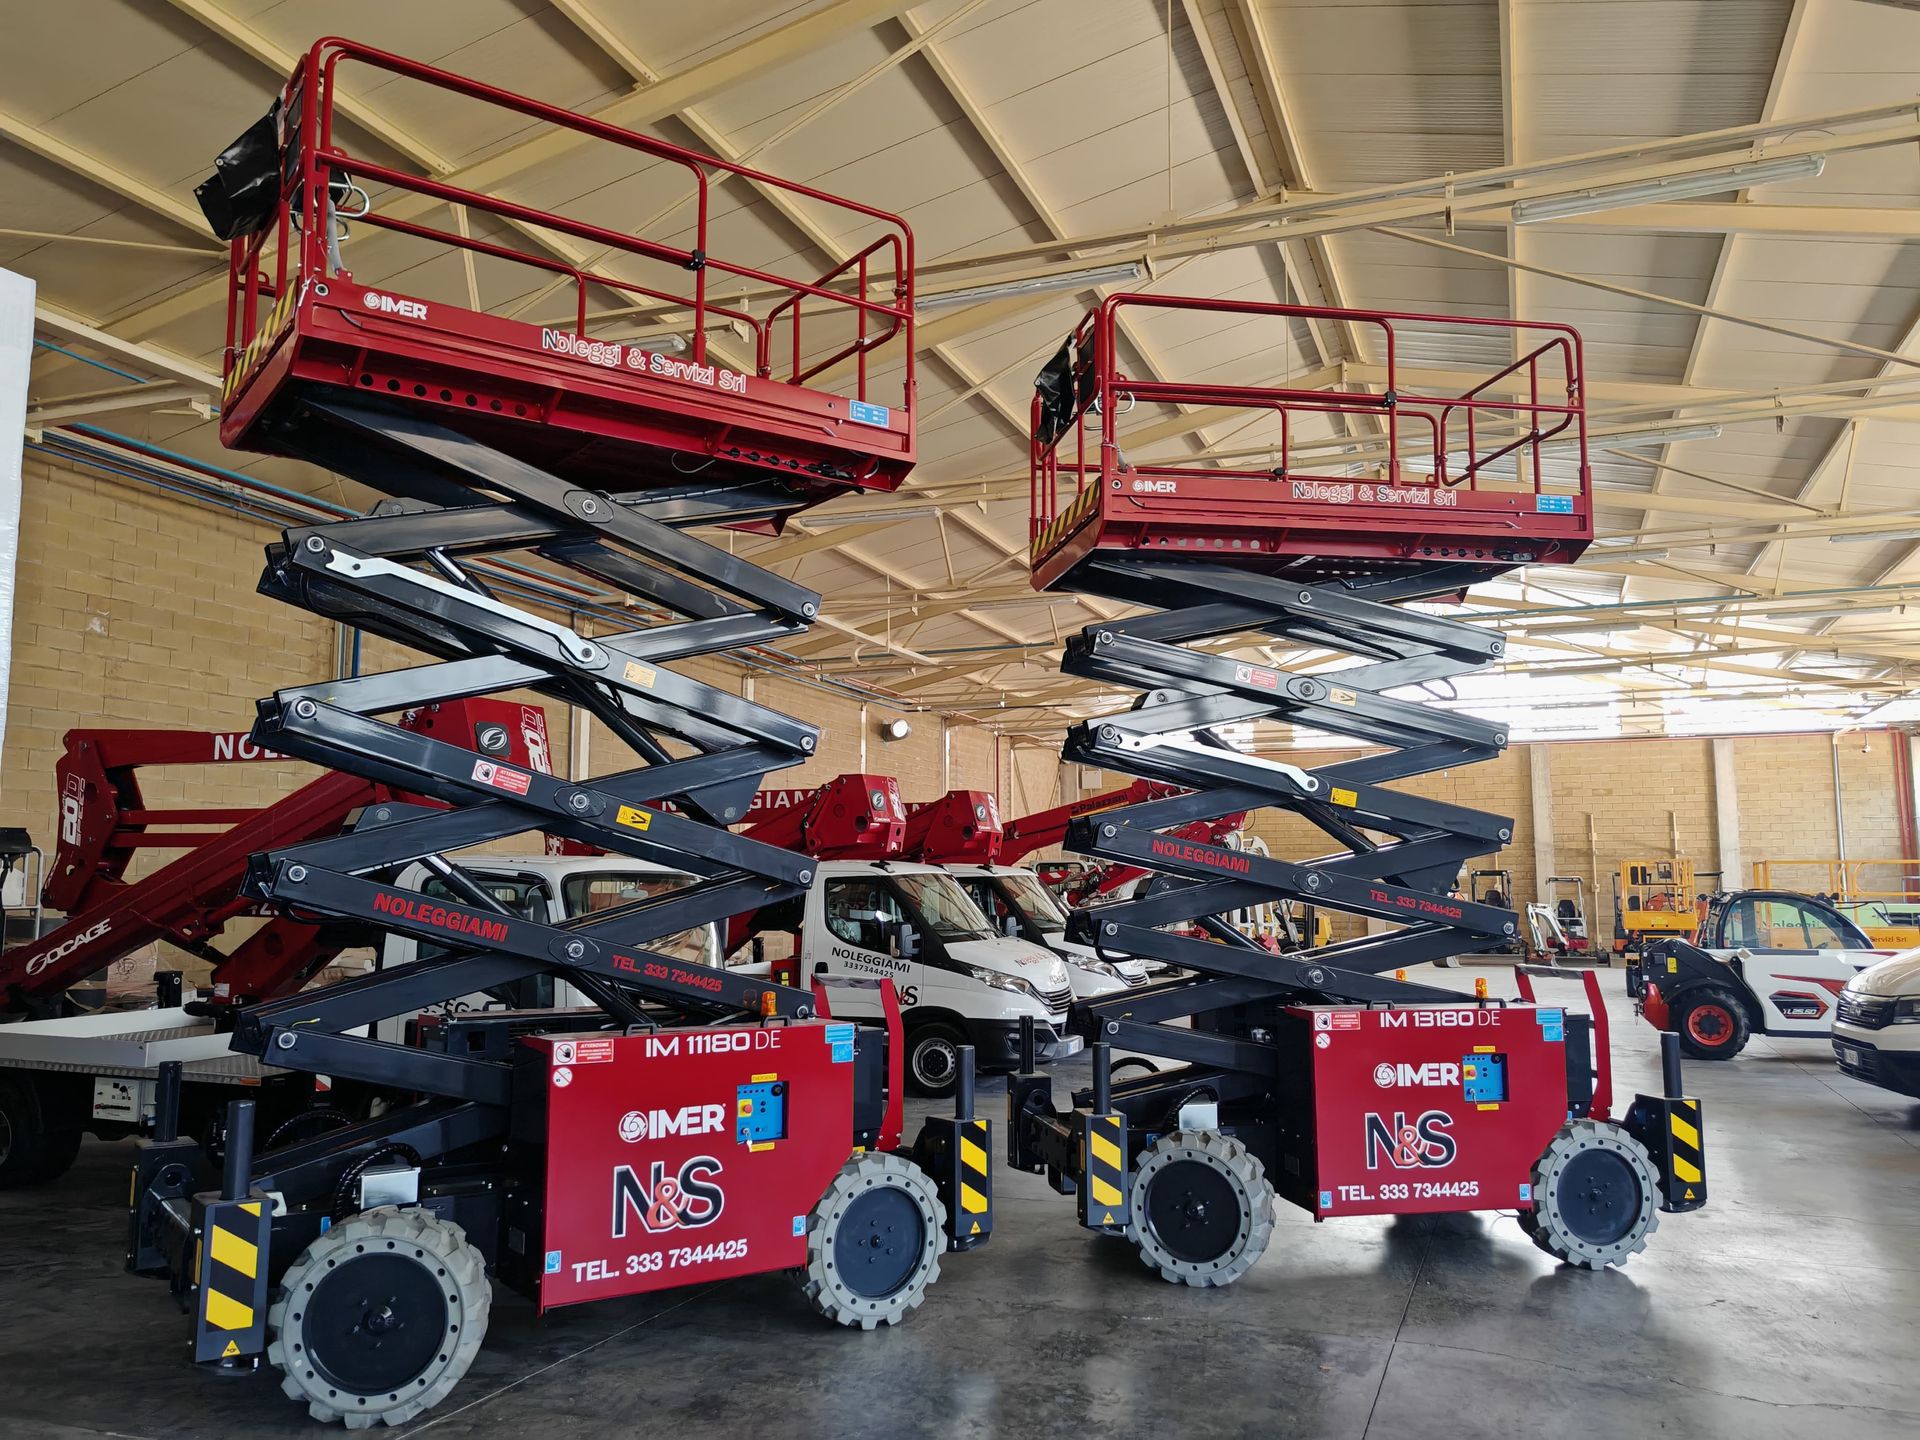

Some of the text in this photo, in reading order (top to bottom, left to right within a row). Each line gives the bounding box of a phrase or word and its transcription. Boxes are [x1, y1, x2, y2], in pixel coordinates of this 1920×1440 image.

[381, 296, 427, 320] IMER
[543, 328, 746, 392] Noleggi & Servizi Srl
[1144, 481, 1176, 492] IMER
[1293, 482, 1456, 505] Noleggi & Servizi Srl
[1152, 840, 1249, 873] NOLEGGIAMI
[373, 893, 508, 942] NOLEGGIAMI
[1396, 896, 1416, 908] 333
[1419, 900, 1462, 919] 7344425
[831, 947, 911, 973] NOLEGGIAMI
[844, 961, 894, 978] 3337344425
[644, 963, 668, 979] 333
[671, 969, 722, 992] 7344425
[1380, 1011, 1500, 1027] IM 13180 DE
[645, 1030, 781, 1057] IM 11180 DE
[1397, 1063, 1459, 1087] IMER
[649, 1104, 727, 1140] IMER
[1365, 1110, 1456, 1169] N&S
[612, 1156, 724, 1238] N&S
[1338, 1181, 1479, 1201] TEL. 333 7344425
[572, 1239, 748, 1283] TEL. 333 7344425
